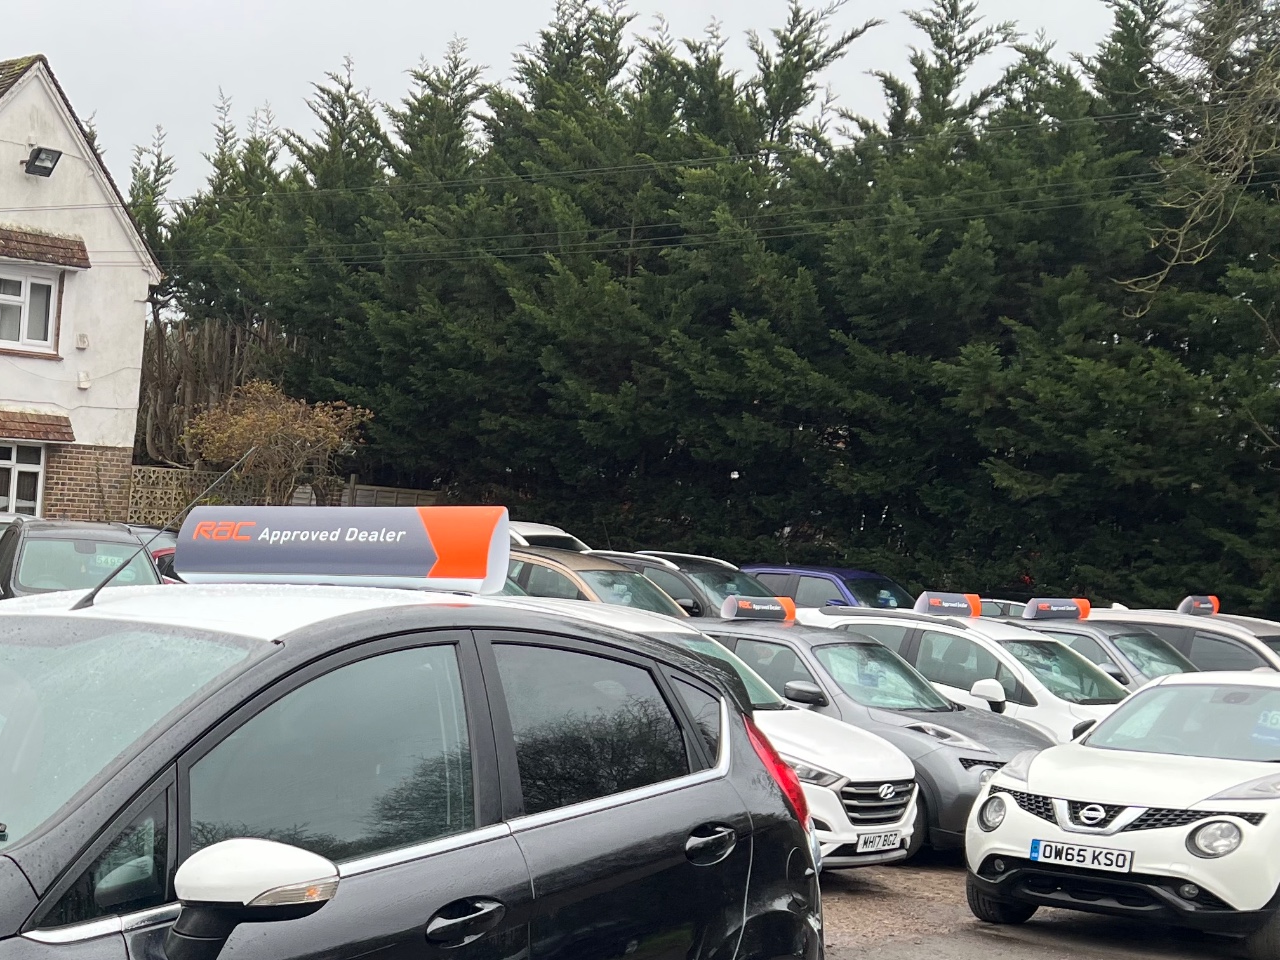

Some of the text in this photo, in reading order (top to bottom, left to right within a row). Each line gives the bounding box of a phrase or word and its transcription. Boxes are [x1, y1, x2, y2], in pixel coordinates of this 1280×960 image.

[192, 521, 407, 545] RAC Approved Dealer
[862, 834, 882, 849] MH17
[1042, 843, 1127, 868] OW65 KSO
